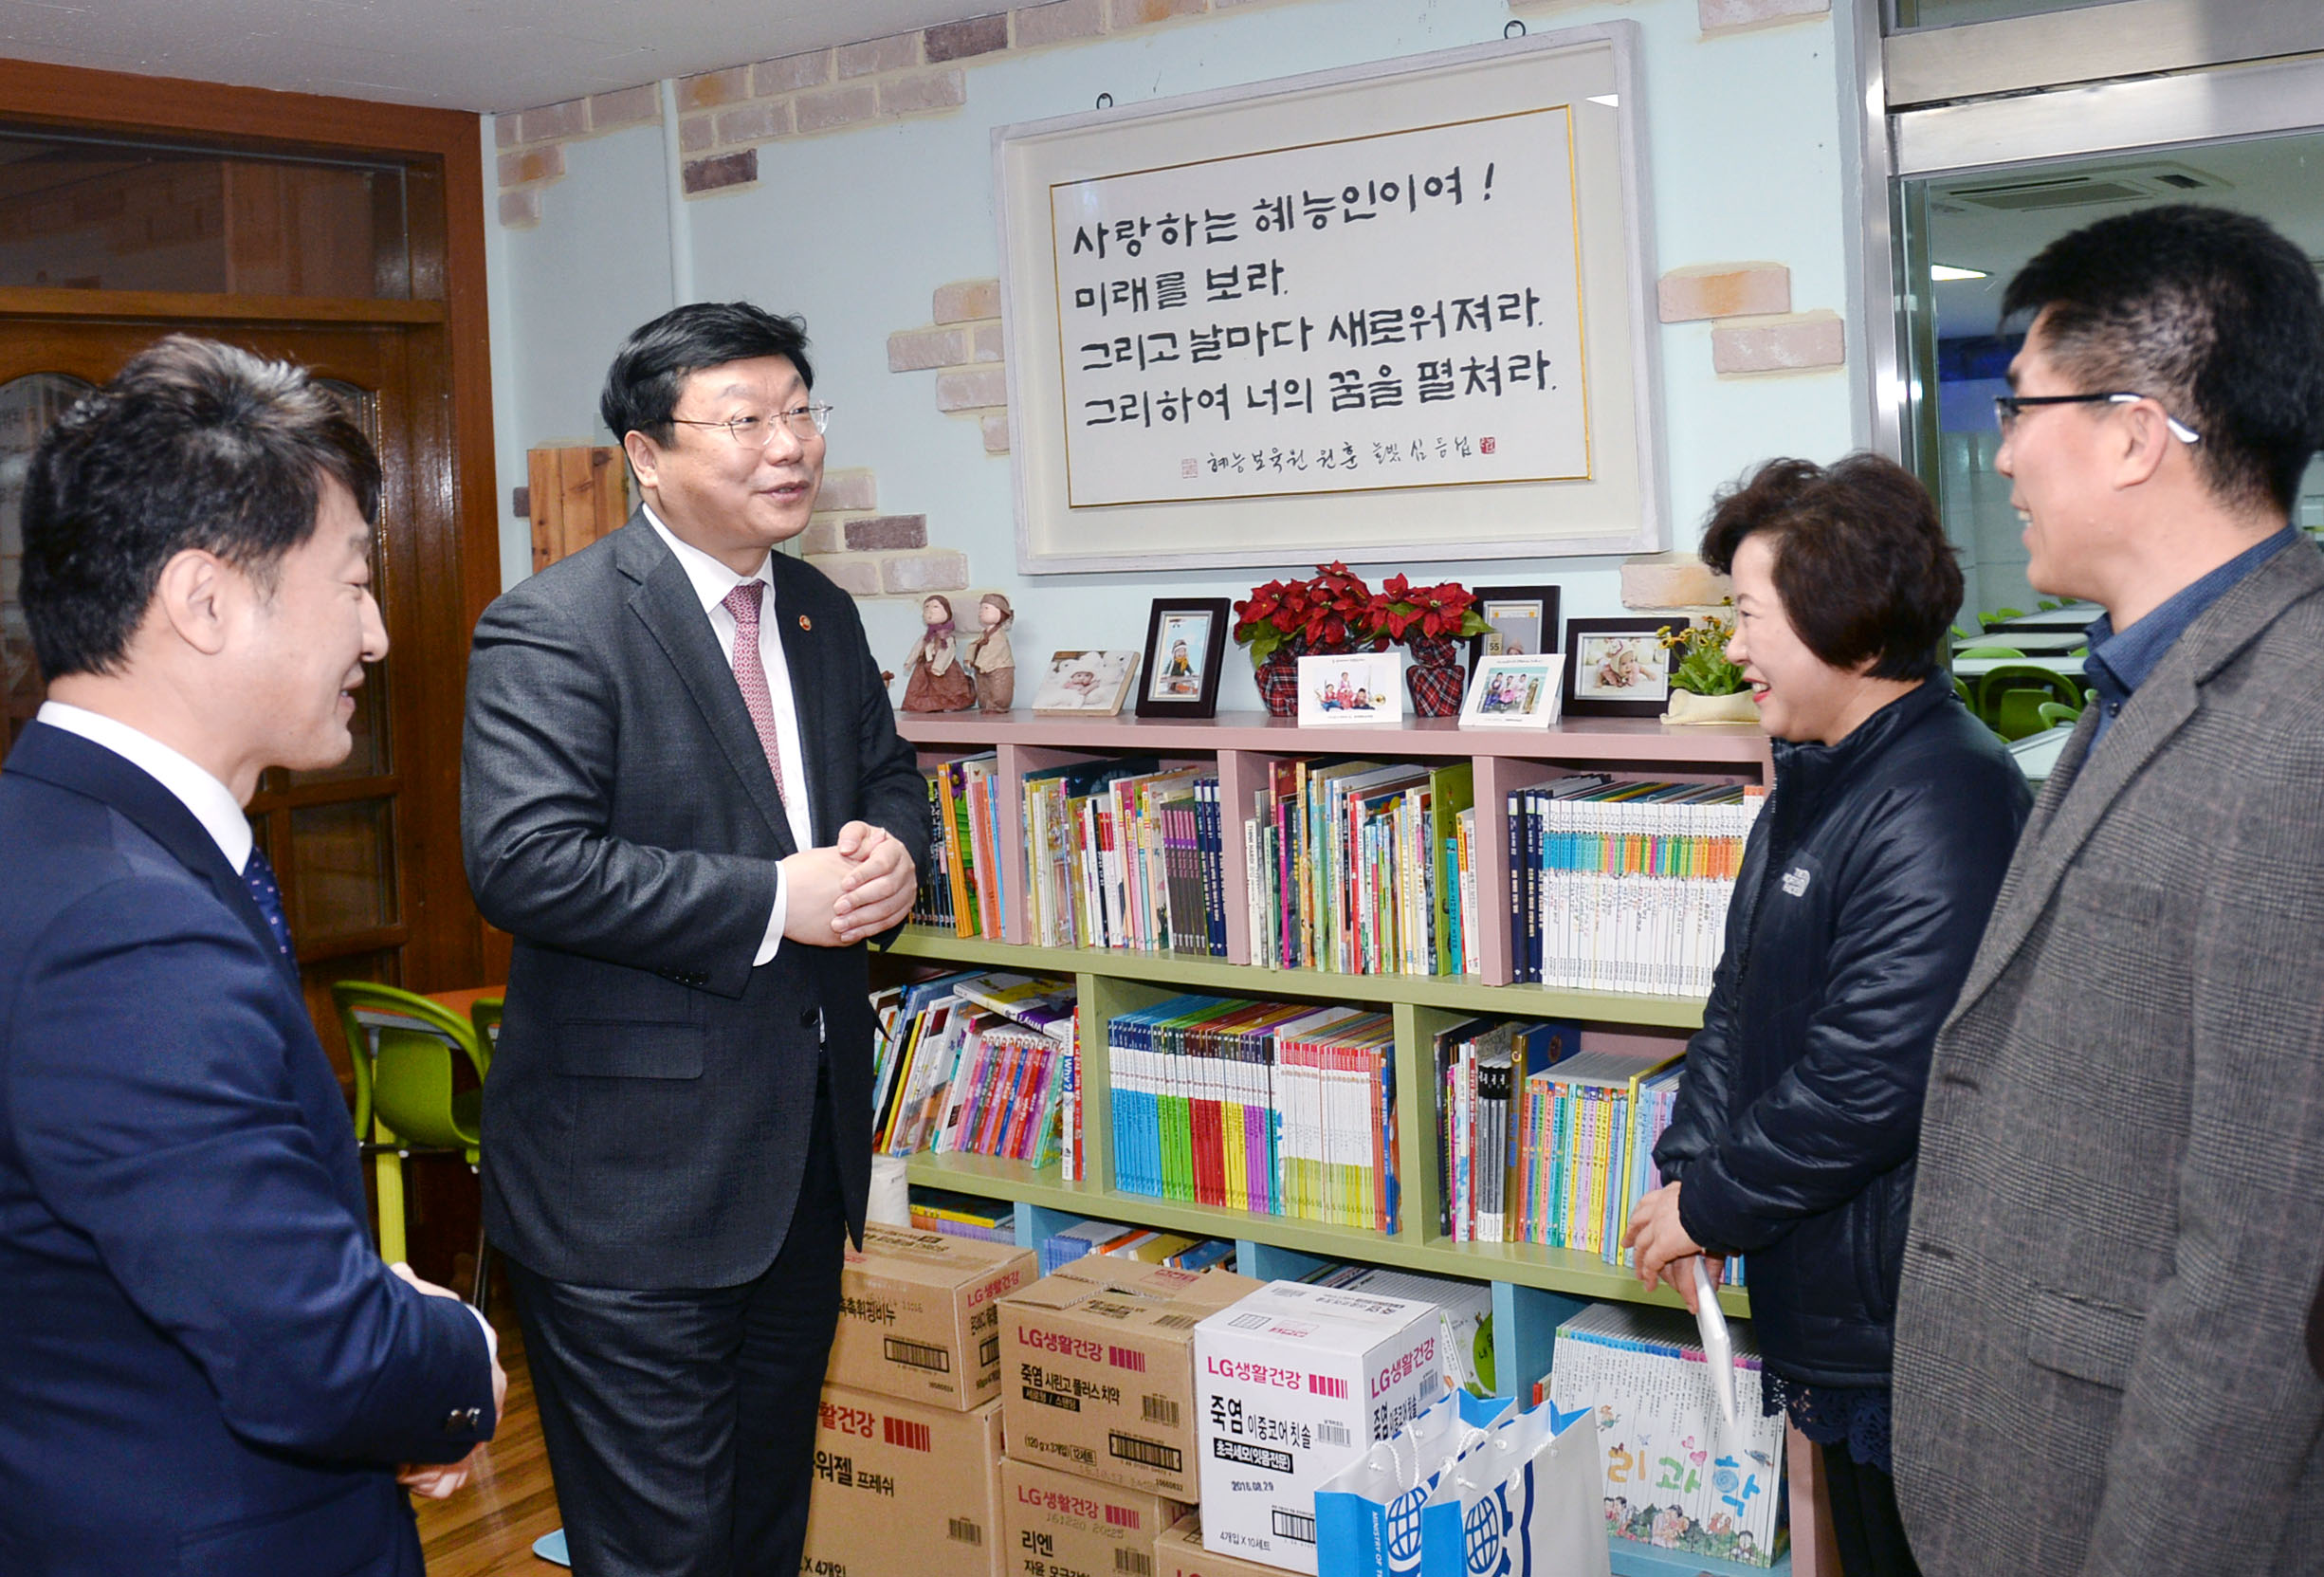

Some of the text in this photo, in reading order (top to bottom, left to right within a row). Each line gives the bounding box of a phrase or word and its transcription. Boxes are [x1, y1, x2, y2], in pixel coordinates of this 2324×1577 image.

[1072, 208, 1238, 259] 사랑하는
[1074, 259, 1289, 317] 미래를 보라.
[1084, 349, 1558, 428] 그리하여 너의 꿈을 펼쳐라.
[1064, 1057, 1073, 1091] Why?
[1017, 1325, 1104, 1363] LG생활건강
[1020, 1363, 1043, 1388] 죽염
[1072, 1378, 1100, 1401] 플러스
[1101, 1384, 1121, 1406] 치약
[1207, 1355, 1302, 1391] LG생활건강
[1371, 1336, 1436, 1400] LG생활건강
[1210, 1394, 1312, 1450] 죽염 이중코어 칫솔
[1373, 1401, 1389, 1441] 죽염
[814, 1450, 895, 1498] 워젤 프레쉬
[1017, 1484, 1100, 1520] LG생활건강
[1021, 1530, 1054, 1558] 리엔
[1371, 1510, 1382, 1553] MINISTRY
[1374, 1552, 1383, 1568] OF
